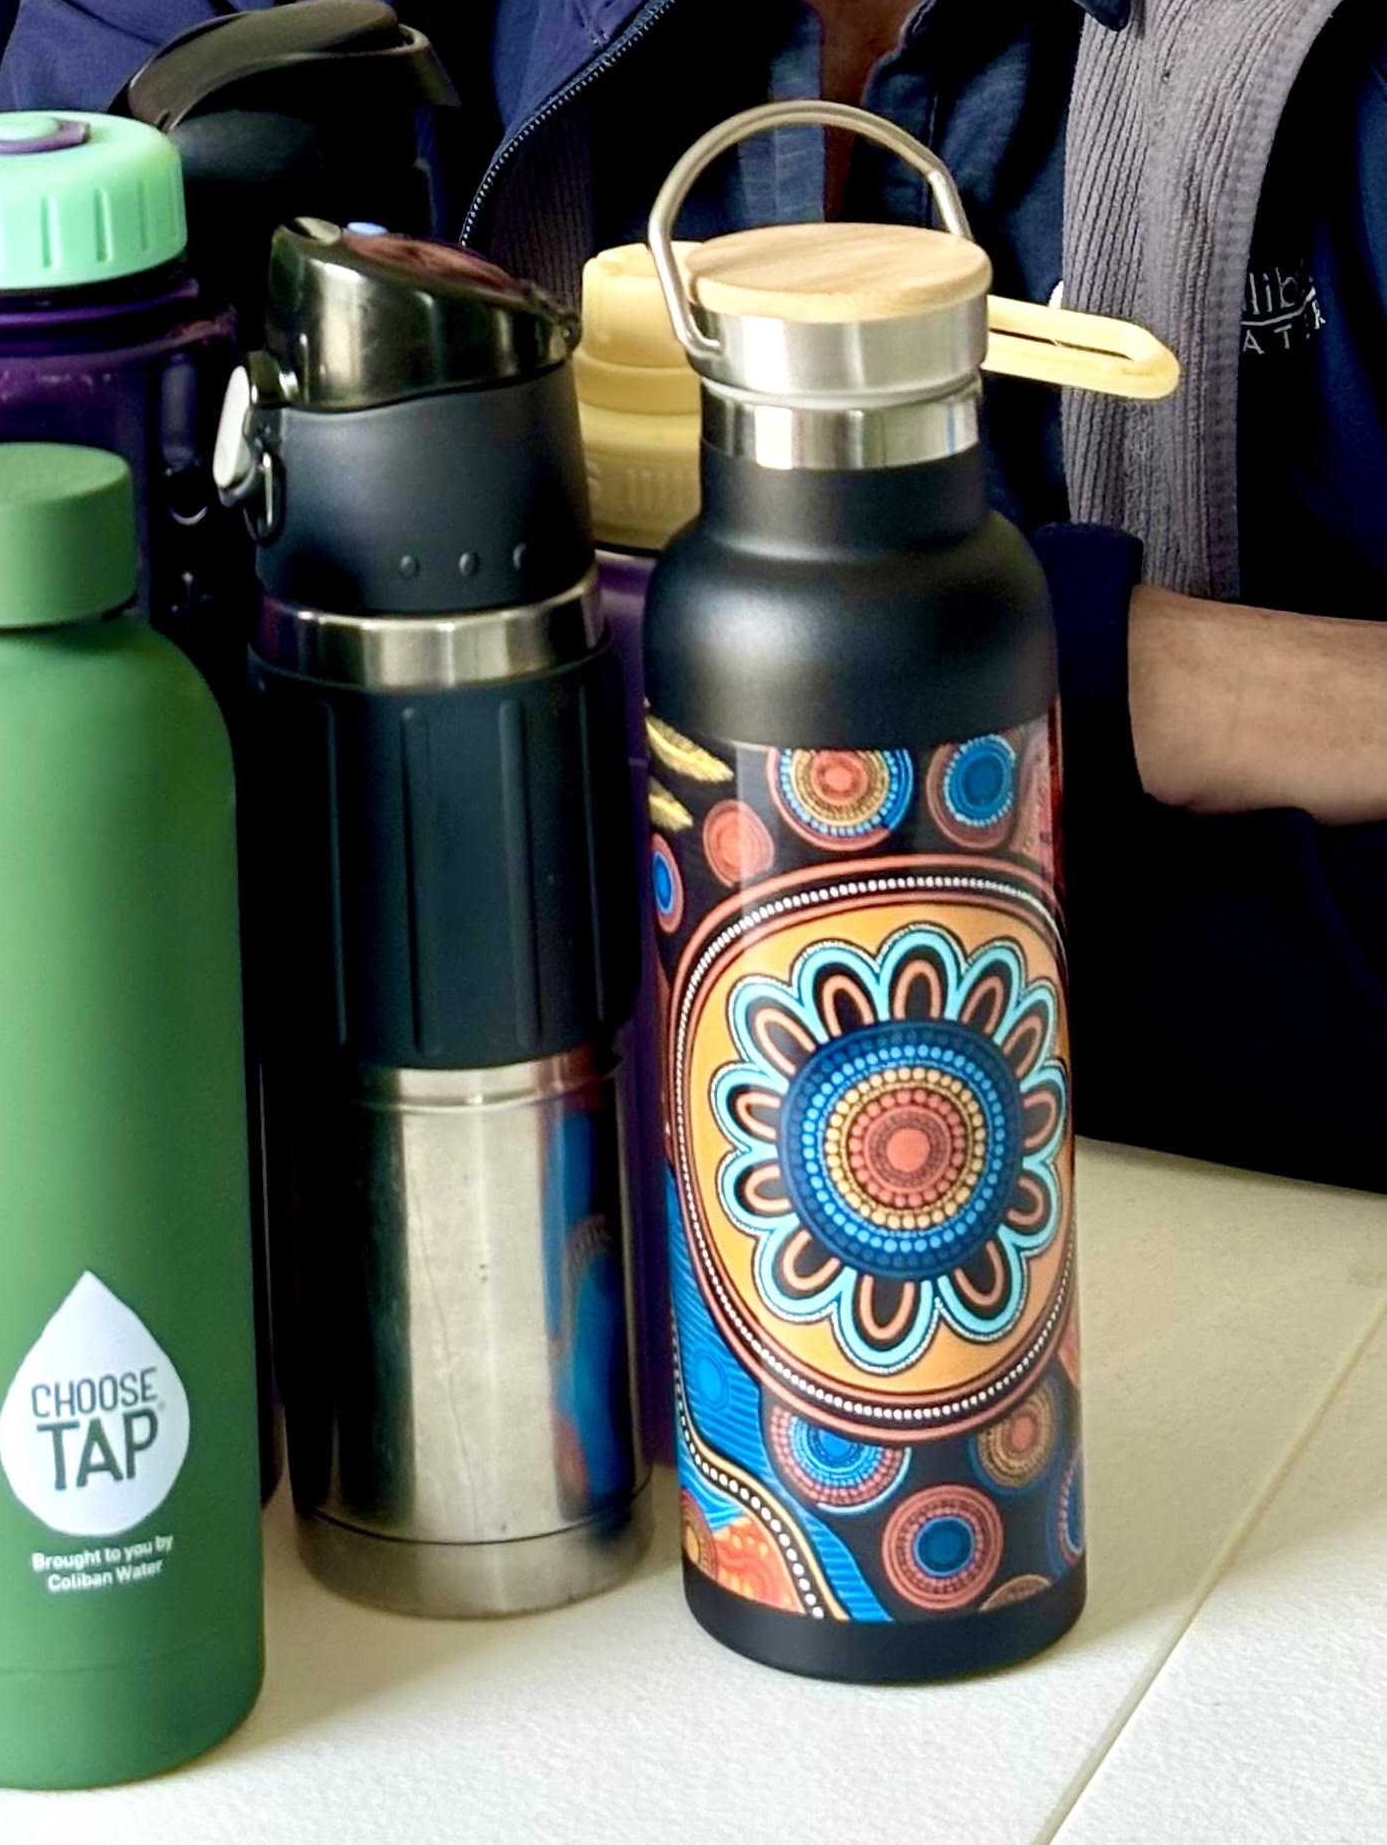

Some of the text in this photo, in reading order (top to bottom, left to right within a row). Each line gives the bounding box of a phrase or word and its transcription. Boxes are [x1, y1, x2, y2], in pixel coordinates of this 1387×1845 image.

[31, 1367, 158, 1418] CHOOSE
[36, 1408, 159, 1491] TAP
[32, 1535, 174, 1572] Brought to you by
[48, 1558, 163, 1592] Coliban Water
